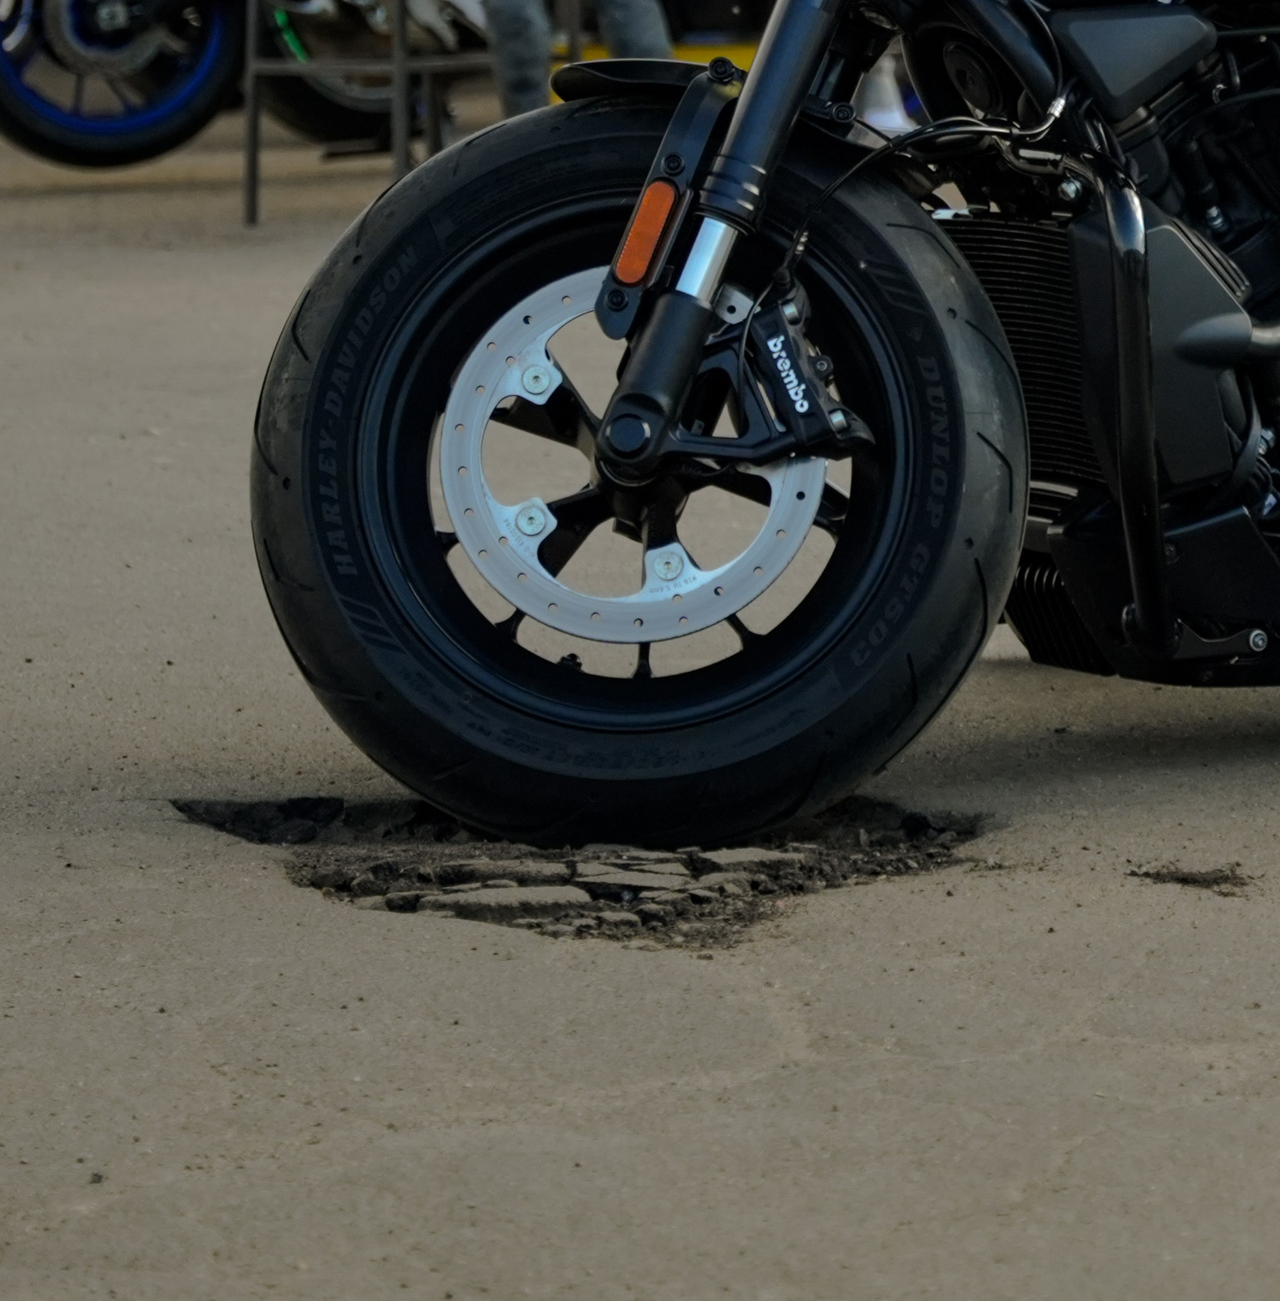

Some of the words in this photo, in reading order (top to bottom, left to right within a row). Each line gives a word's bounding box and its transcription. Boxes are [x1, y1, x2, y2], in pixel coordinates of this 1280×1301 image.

[317, 243, 419, 576] HARLEY-DAVIDSON
[767, 335, 809, 413] brembo
[916, 355, 949, 528] DUNLOP
[852, 543, 931, 667] GT503
